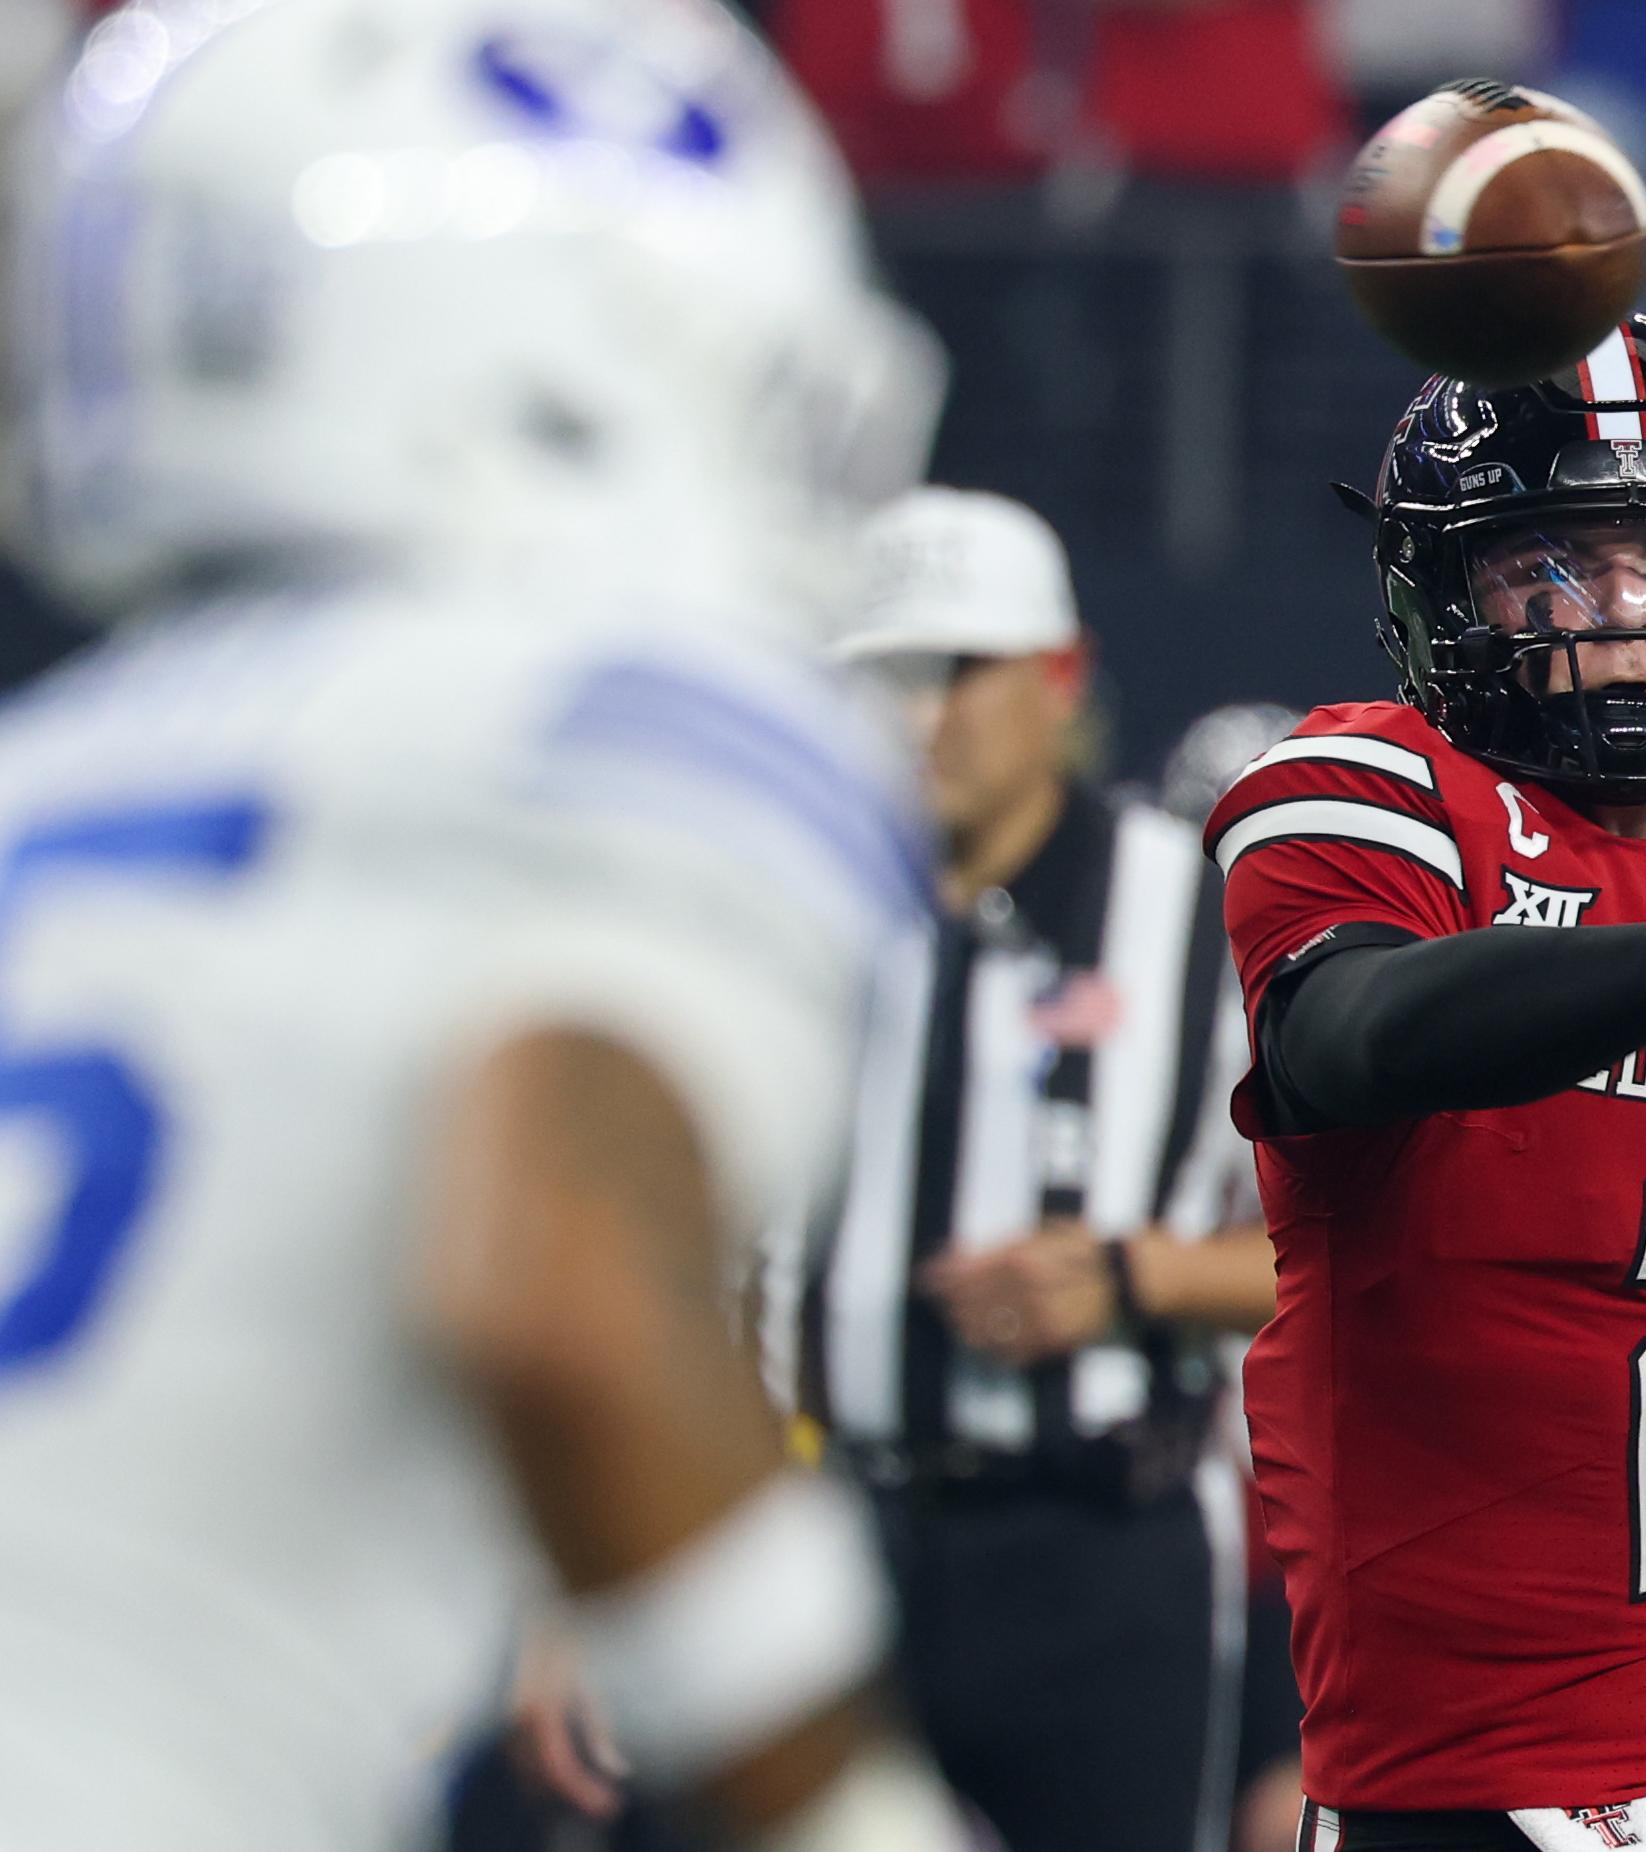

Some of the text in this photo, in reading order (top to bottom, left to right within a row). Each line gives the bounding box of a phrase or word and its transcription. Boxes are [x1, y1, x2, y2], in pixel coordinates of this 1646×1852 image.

[1460, 468, 1502, 492] GUNS UP
[1495, 781, 1550, 859] C
[1490, 868, 1598, 928] XII
